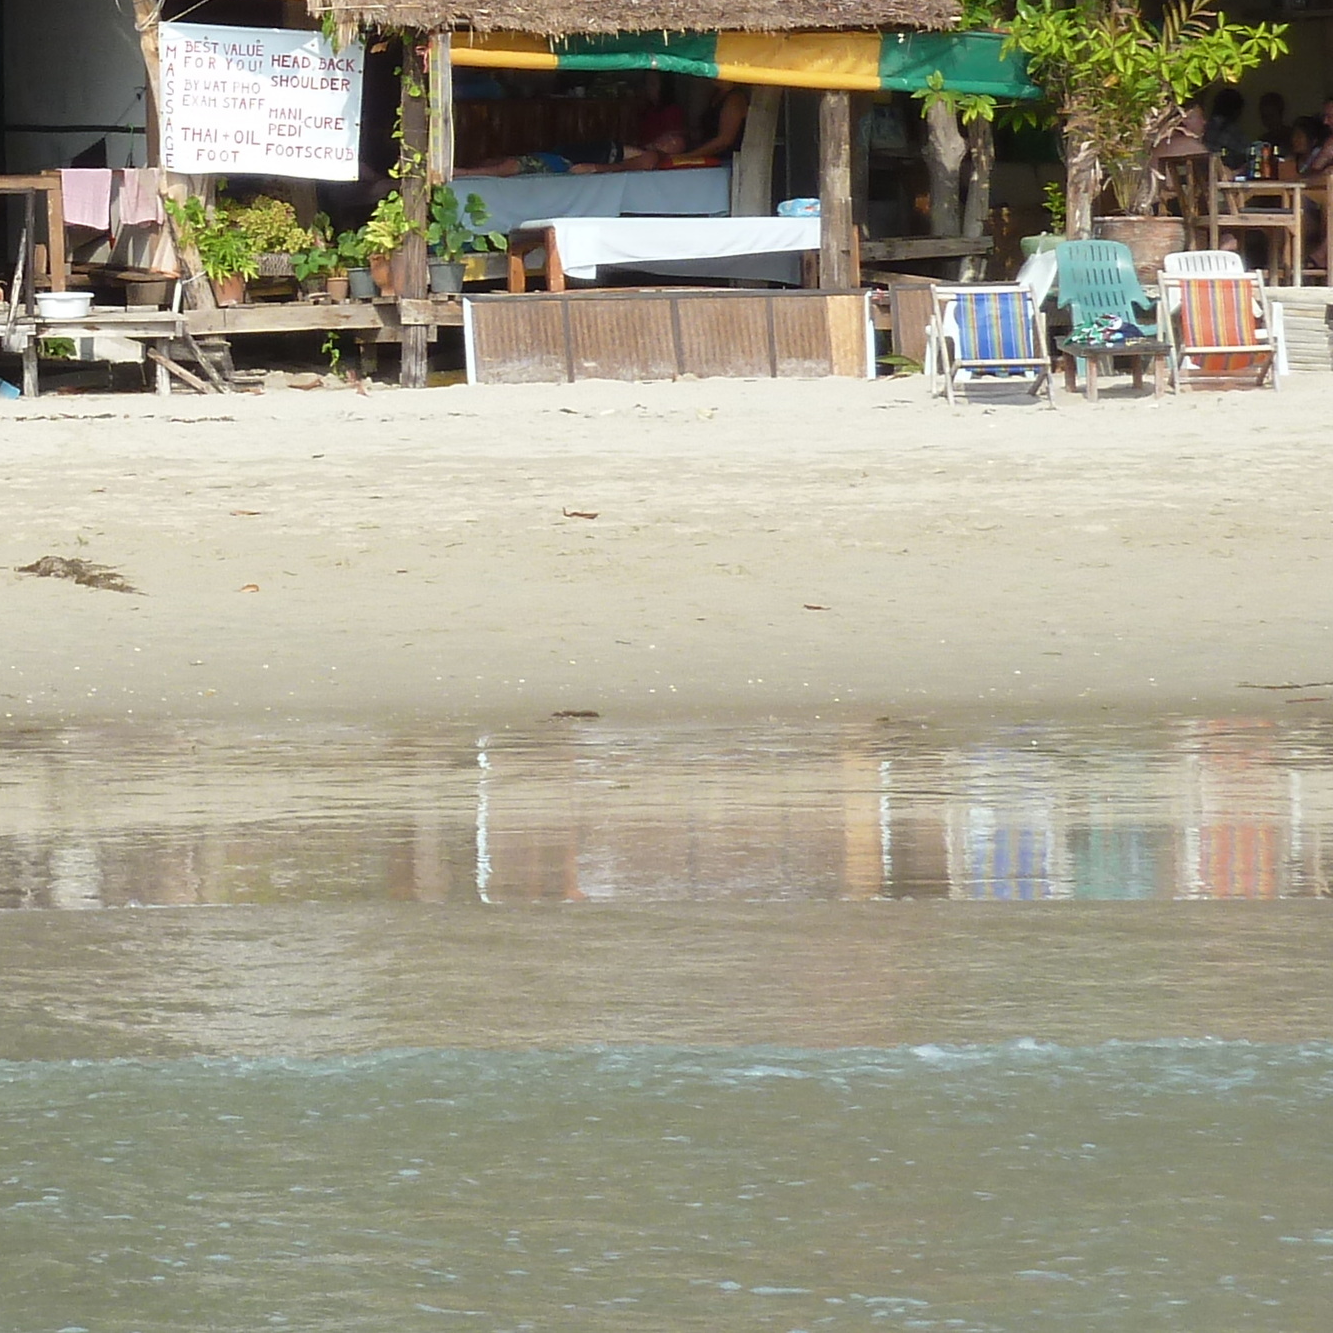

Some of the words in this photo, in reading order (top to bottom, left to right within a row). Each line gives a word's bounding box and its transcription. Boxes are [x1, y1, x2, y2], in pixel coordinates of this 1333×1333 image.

[184, 40, 219, 54] BEST
[223, 43, 264, 57] VALUE
[184, 56, 216, 70] FOR
[225, 57, 263, 75] YOU!
[319, 57, 355, 73] BACK
[184, 79, 199, 91] BY
[204, 80, 228, 93] WAT
[233, 81, 261, 95] PHO
[270, 75, 351, 92] SHOULDER
[165, 45, 177, 168] MASSAGE
[222, 97, 266, 110] STAFF
[269, 107, 302, 120] MANI
[268, 123, 302, 138] PEDI
[303, 116, 345, 130] CURE
[181, 127, 218, 143] THAI
[234, 130, 261, 146] OIL
[196, 148, 240, 163] FOOT
